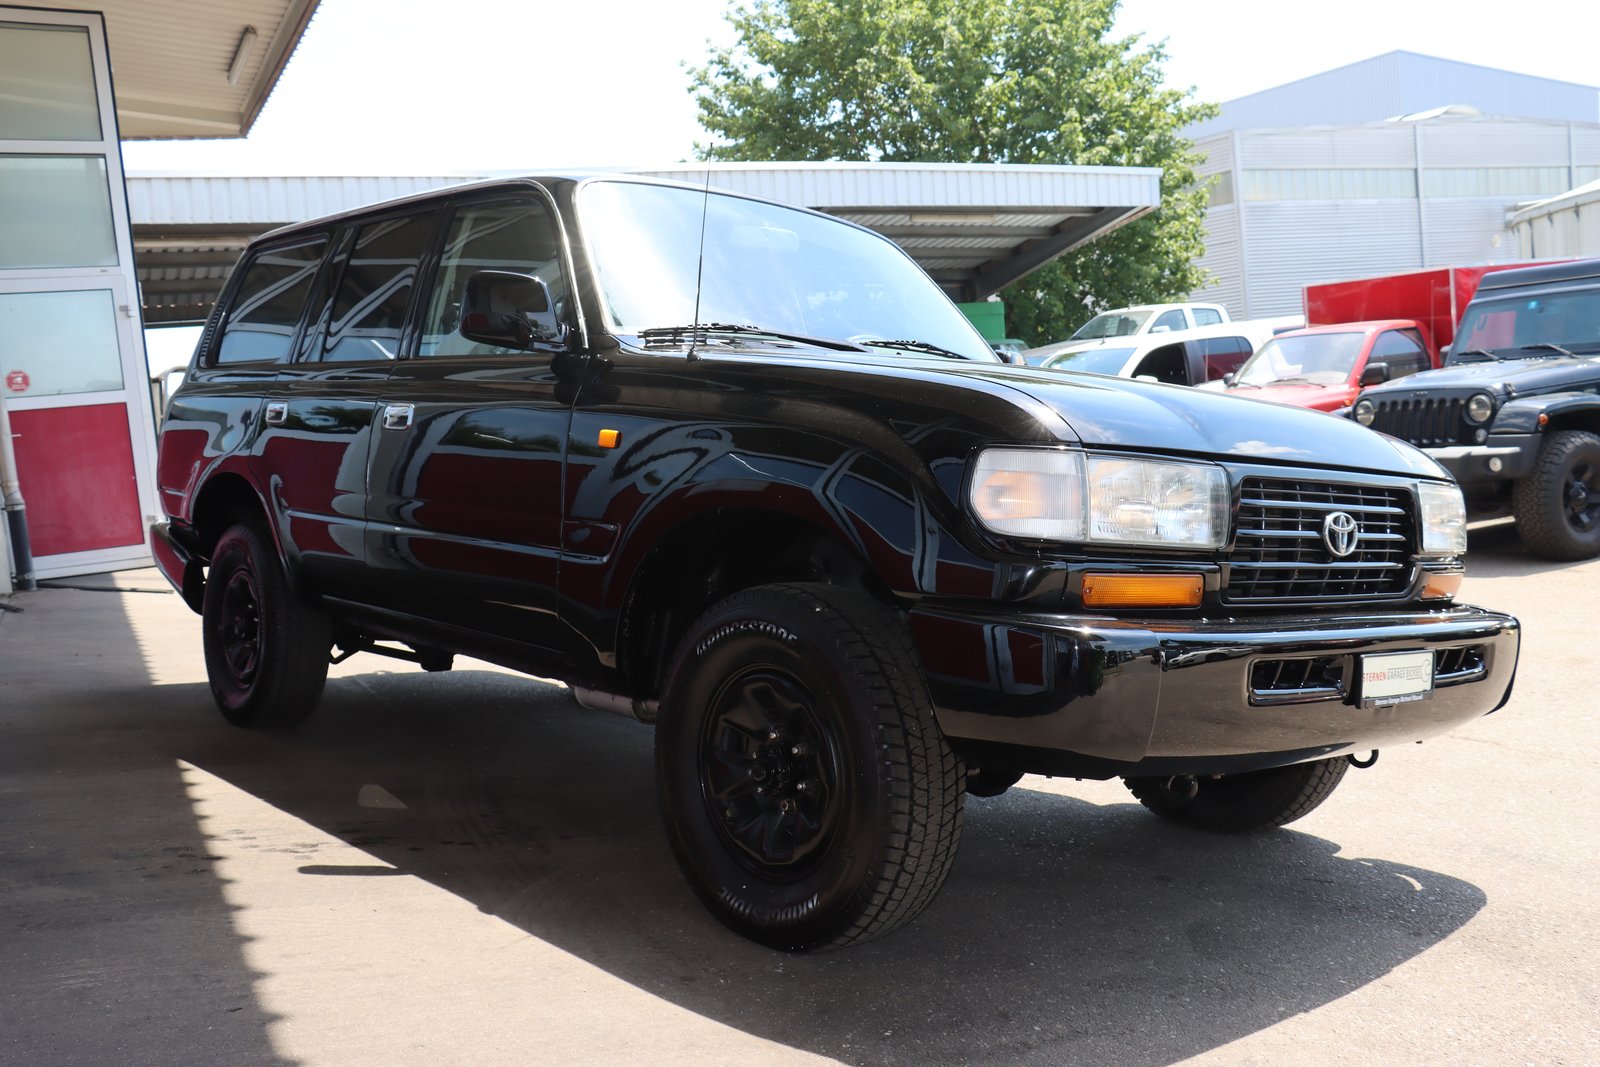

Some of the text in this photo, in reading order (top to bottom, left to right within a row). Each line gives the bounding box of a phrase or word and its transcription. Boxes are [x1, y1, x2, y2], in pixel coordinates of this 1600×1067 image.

[1363, 671, 1387, 682] STERNEN
[1387, 669, 1406, 680] GARAGE
[717, 885, 821, 922] BRIDGTONE
